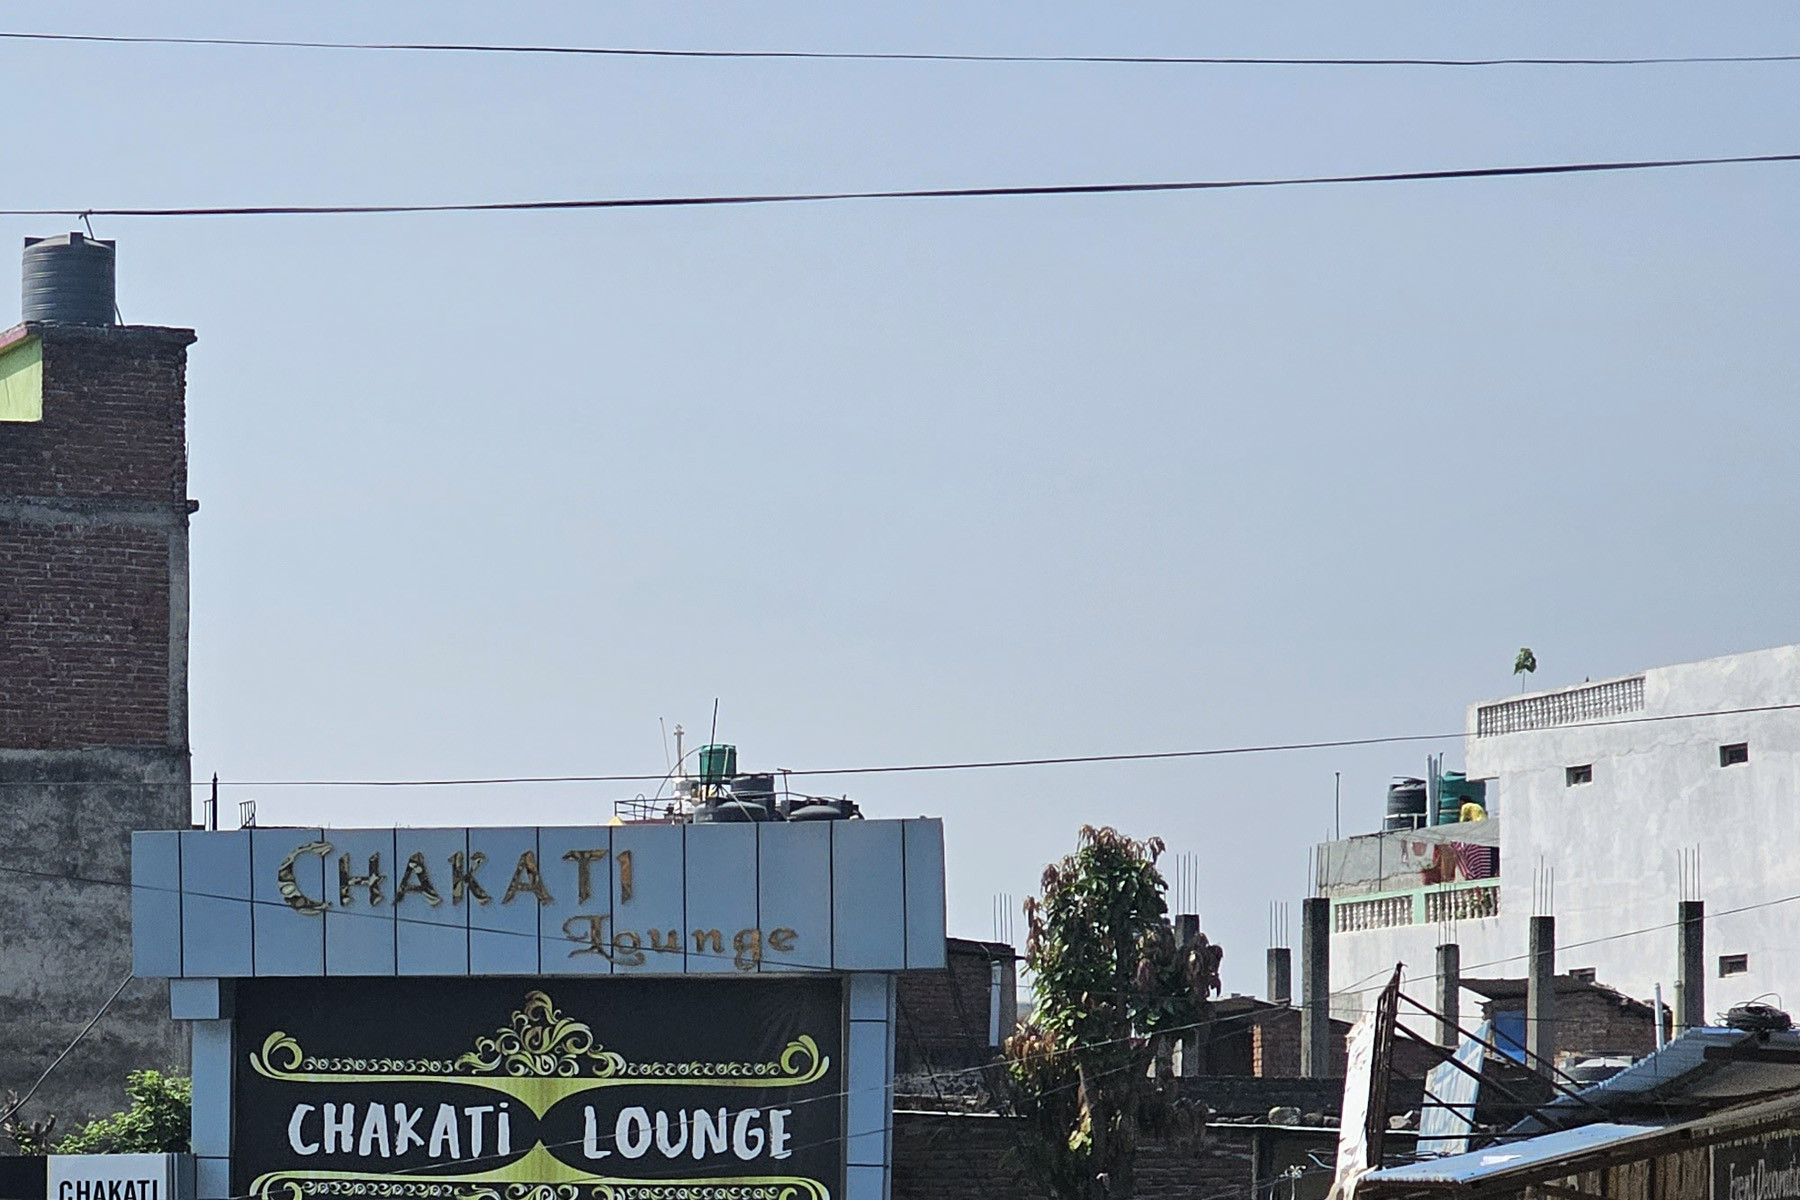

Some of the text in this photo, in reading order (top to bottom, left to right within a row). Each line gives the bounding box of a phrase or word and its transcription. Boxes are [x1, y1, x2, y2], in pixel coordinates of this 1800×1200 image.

[277, 840, 634, 915] CHAKATI
[561, 914, 798, 971] Lounge
[584, 1105, 793, 1161] LOUNGE
